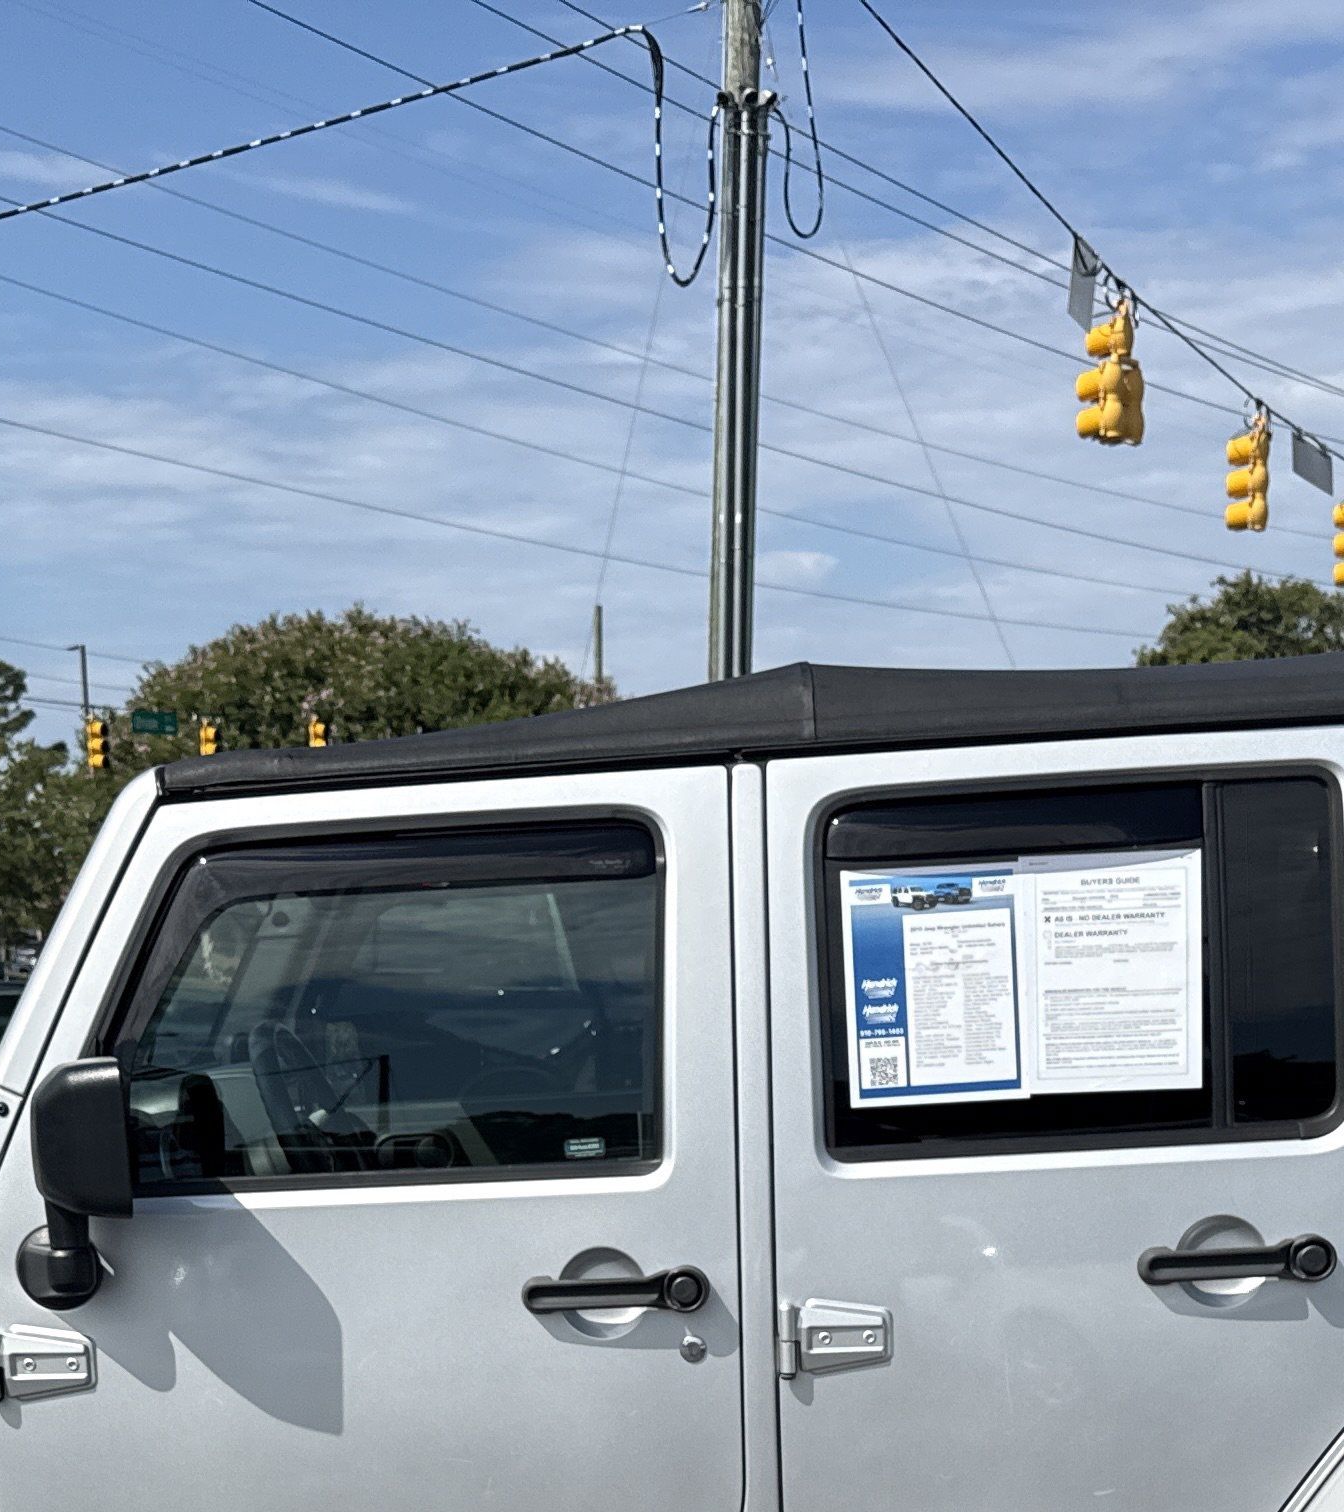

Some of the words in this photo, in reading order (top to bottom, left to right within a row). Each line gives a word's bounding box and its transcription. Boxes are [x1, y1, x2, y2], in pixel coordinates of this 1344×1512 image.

[1116, 877, 1140, 885] GUIDE
[1092, 913, 1121, 921] DEALER
[1123, 911, 1166, 919] WARRANTY
[1054, 931, 1084, 939] DEALER
[1086, 929, 1128, 937] WARRANTY
